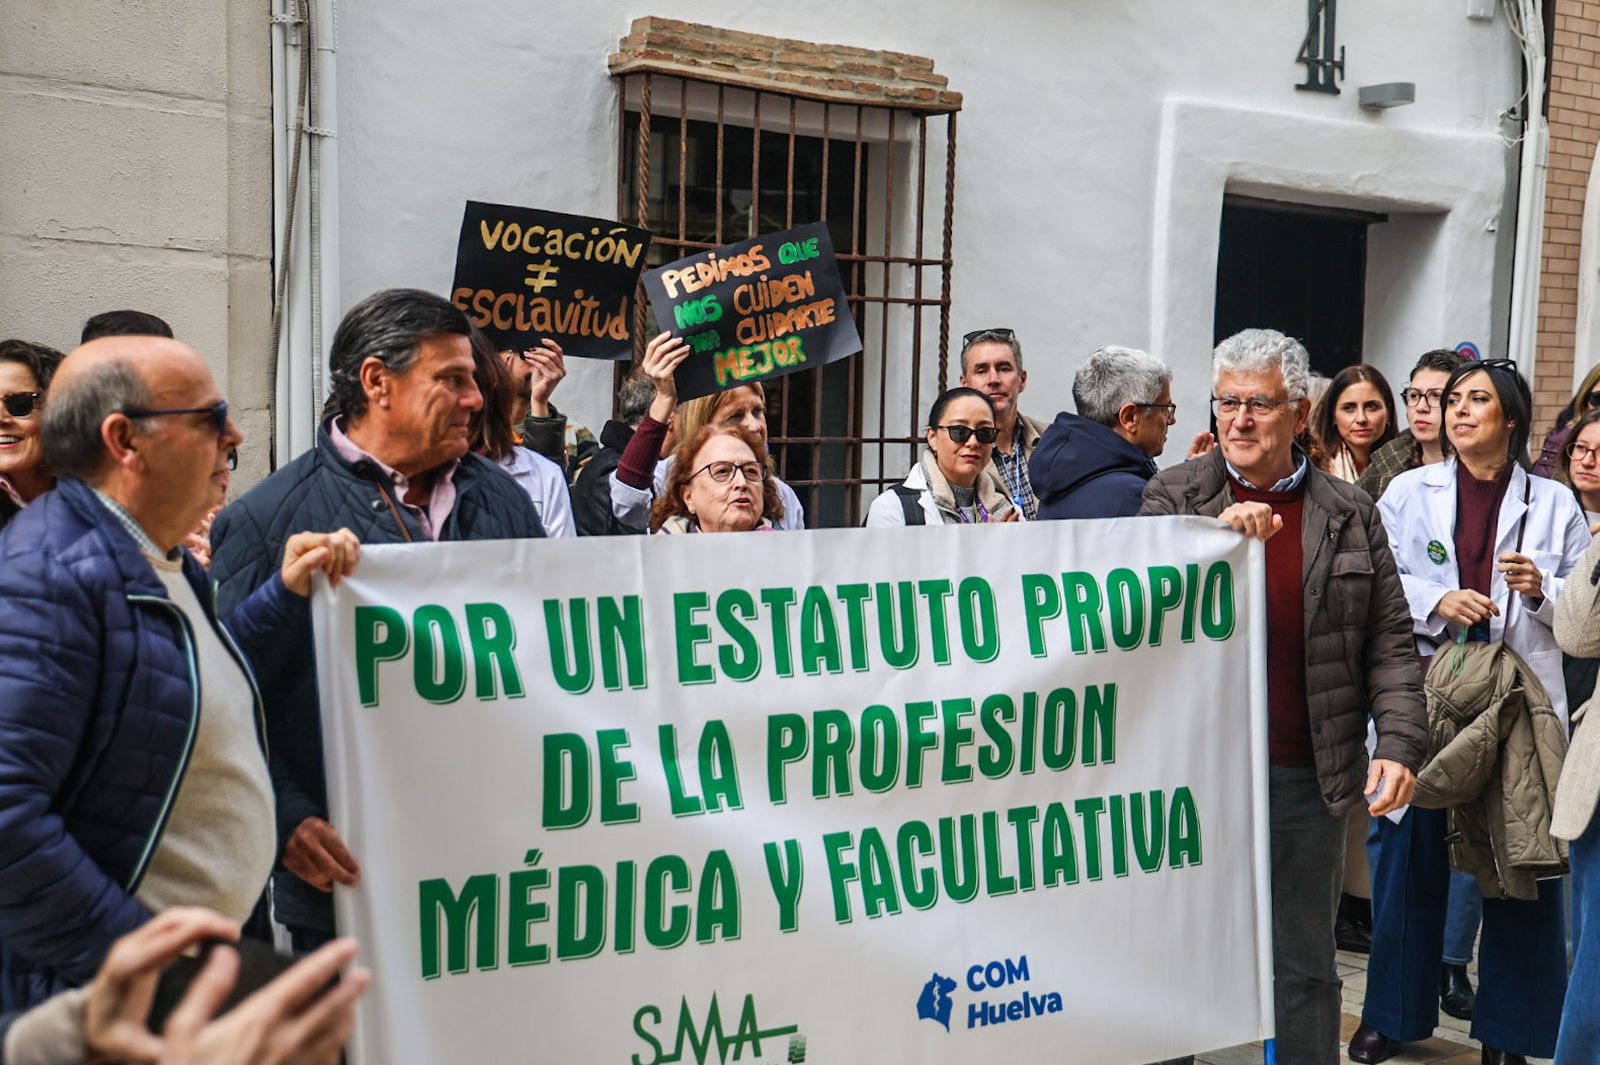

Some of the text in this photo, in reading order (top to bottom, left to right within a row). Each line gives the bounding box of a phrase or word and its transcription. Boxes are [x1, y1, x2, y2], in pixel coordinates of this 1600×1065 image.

[778, 236, 820, 265] QUE
[673, 294, 723, 330] NOS
[713, 336, 807, 386] MEJOR
[354, 560, 1236, 707] POR UN ESTATUTO PROPIO
[542, 683, 1118, 830] DE LA PROFESION
[418, 785, 1204, 980] MÉDICA Y FACULTATIVA
[631, 989, 798, 1065] SMA
[966, 955, 1063, 1029] COM Huelva
